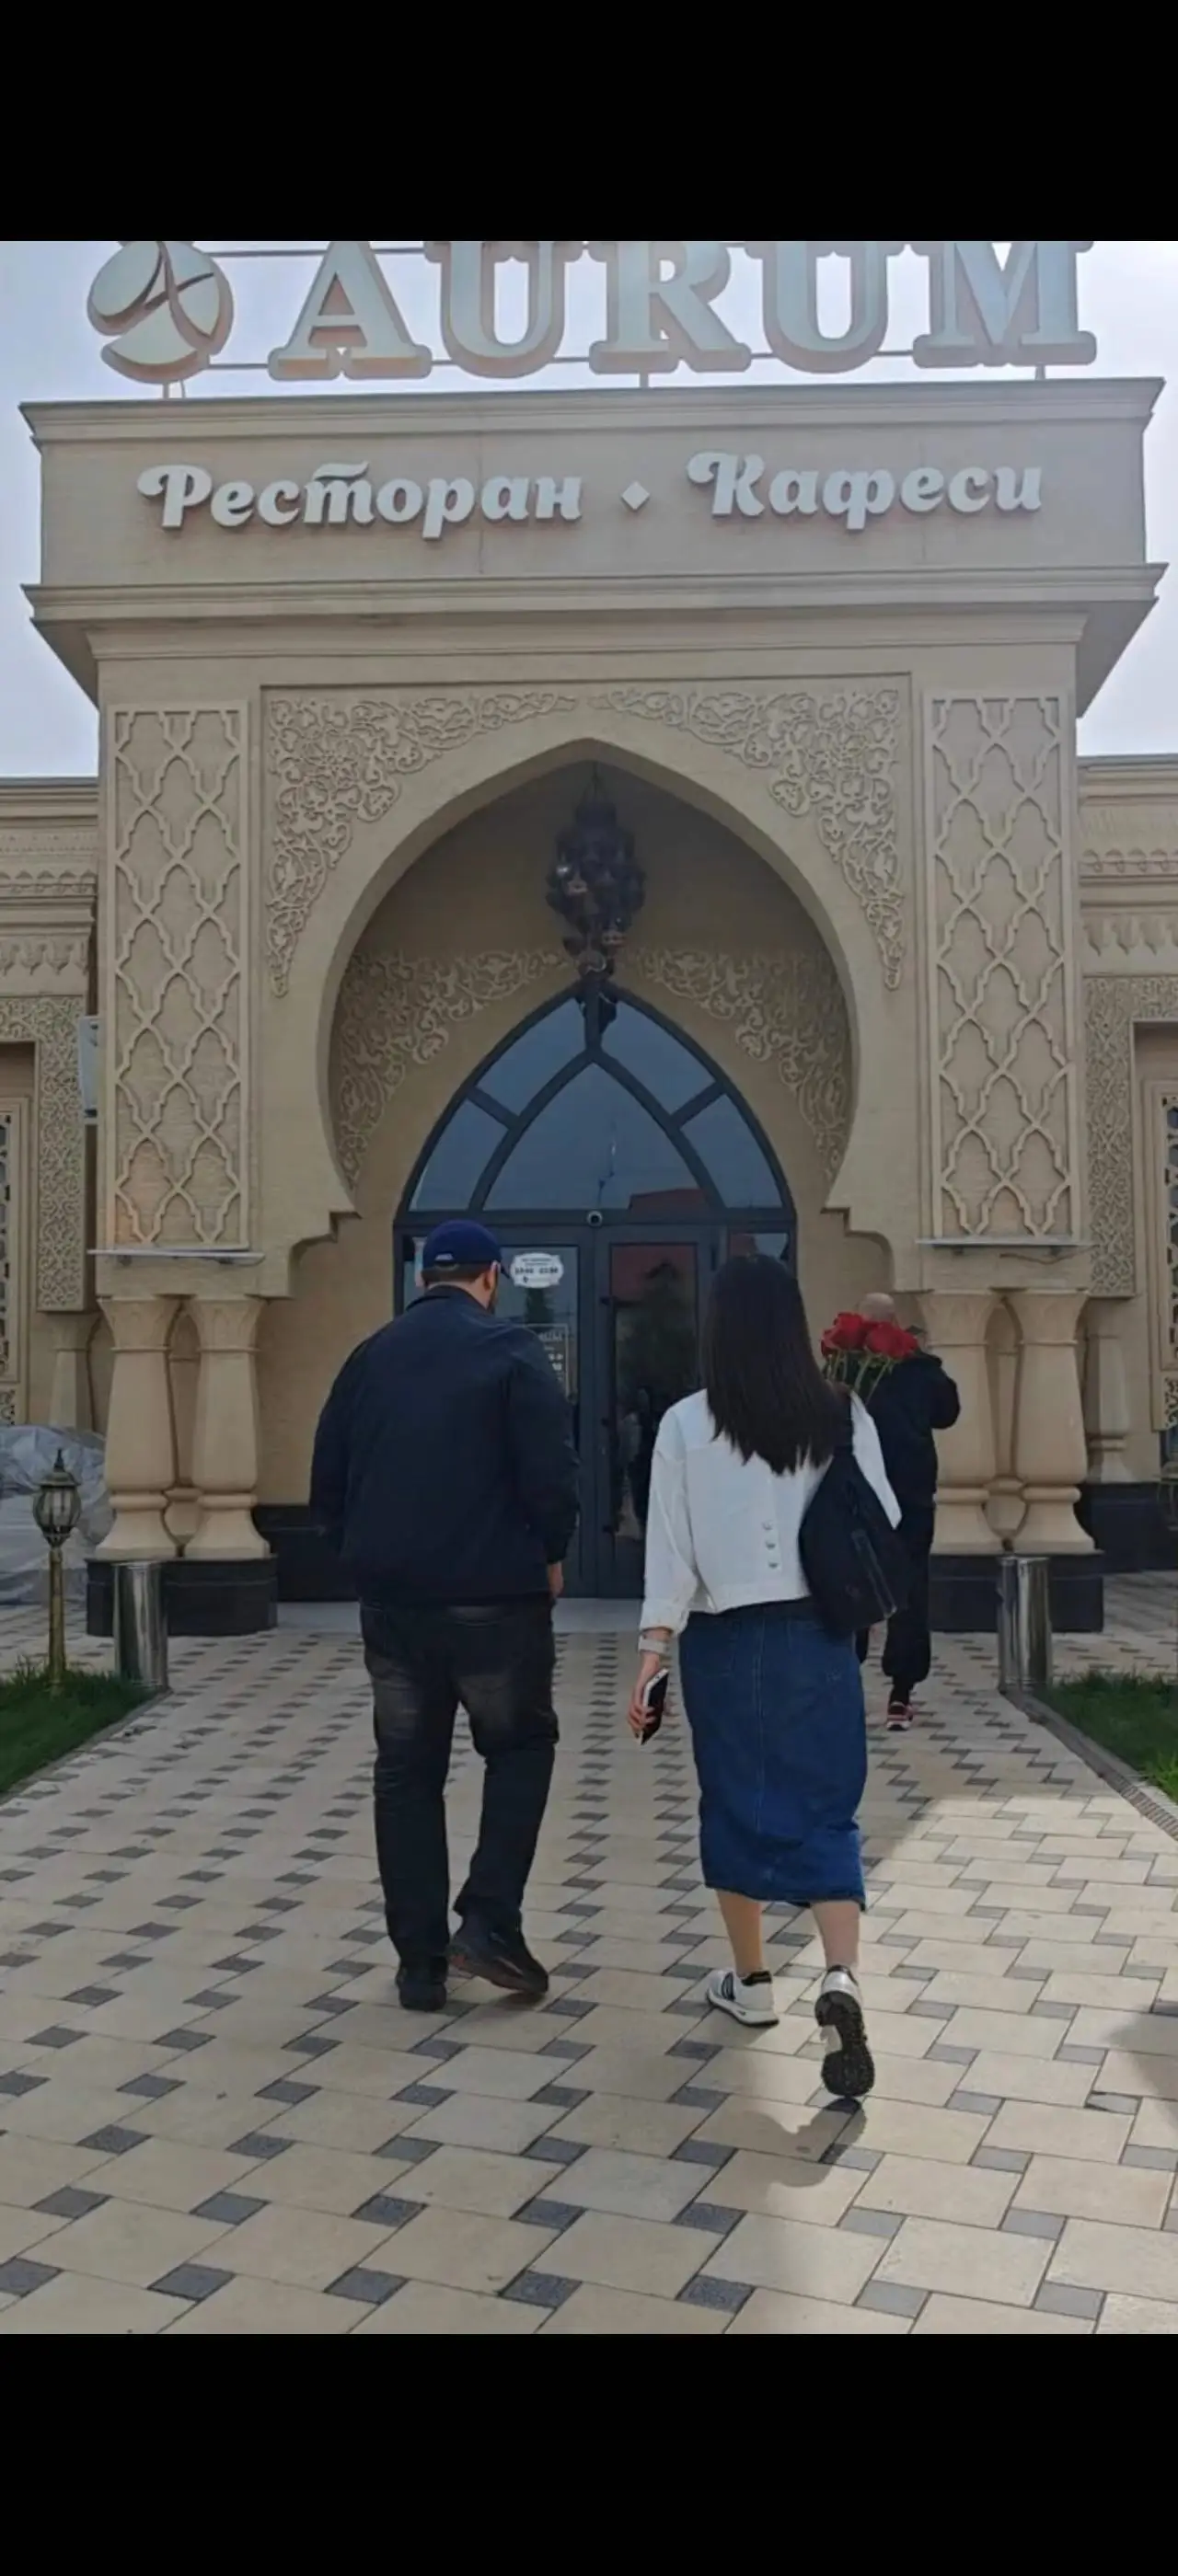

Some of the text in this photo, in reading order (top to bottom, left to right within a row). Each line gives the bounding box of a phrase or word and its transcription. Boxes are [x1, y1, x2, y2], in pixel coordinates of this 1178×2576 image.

[268, 241, 1097, 379] AURUM
[137, 452, 1042, 540] Ресторан Кафеси
